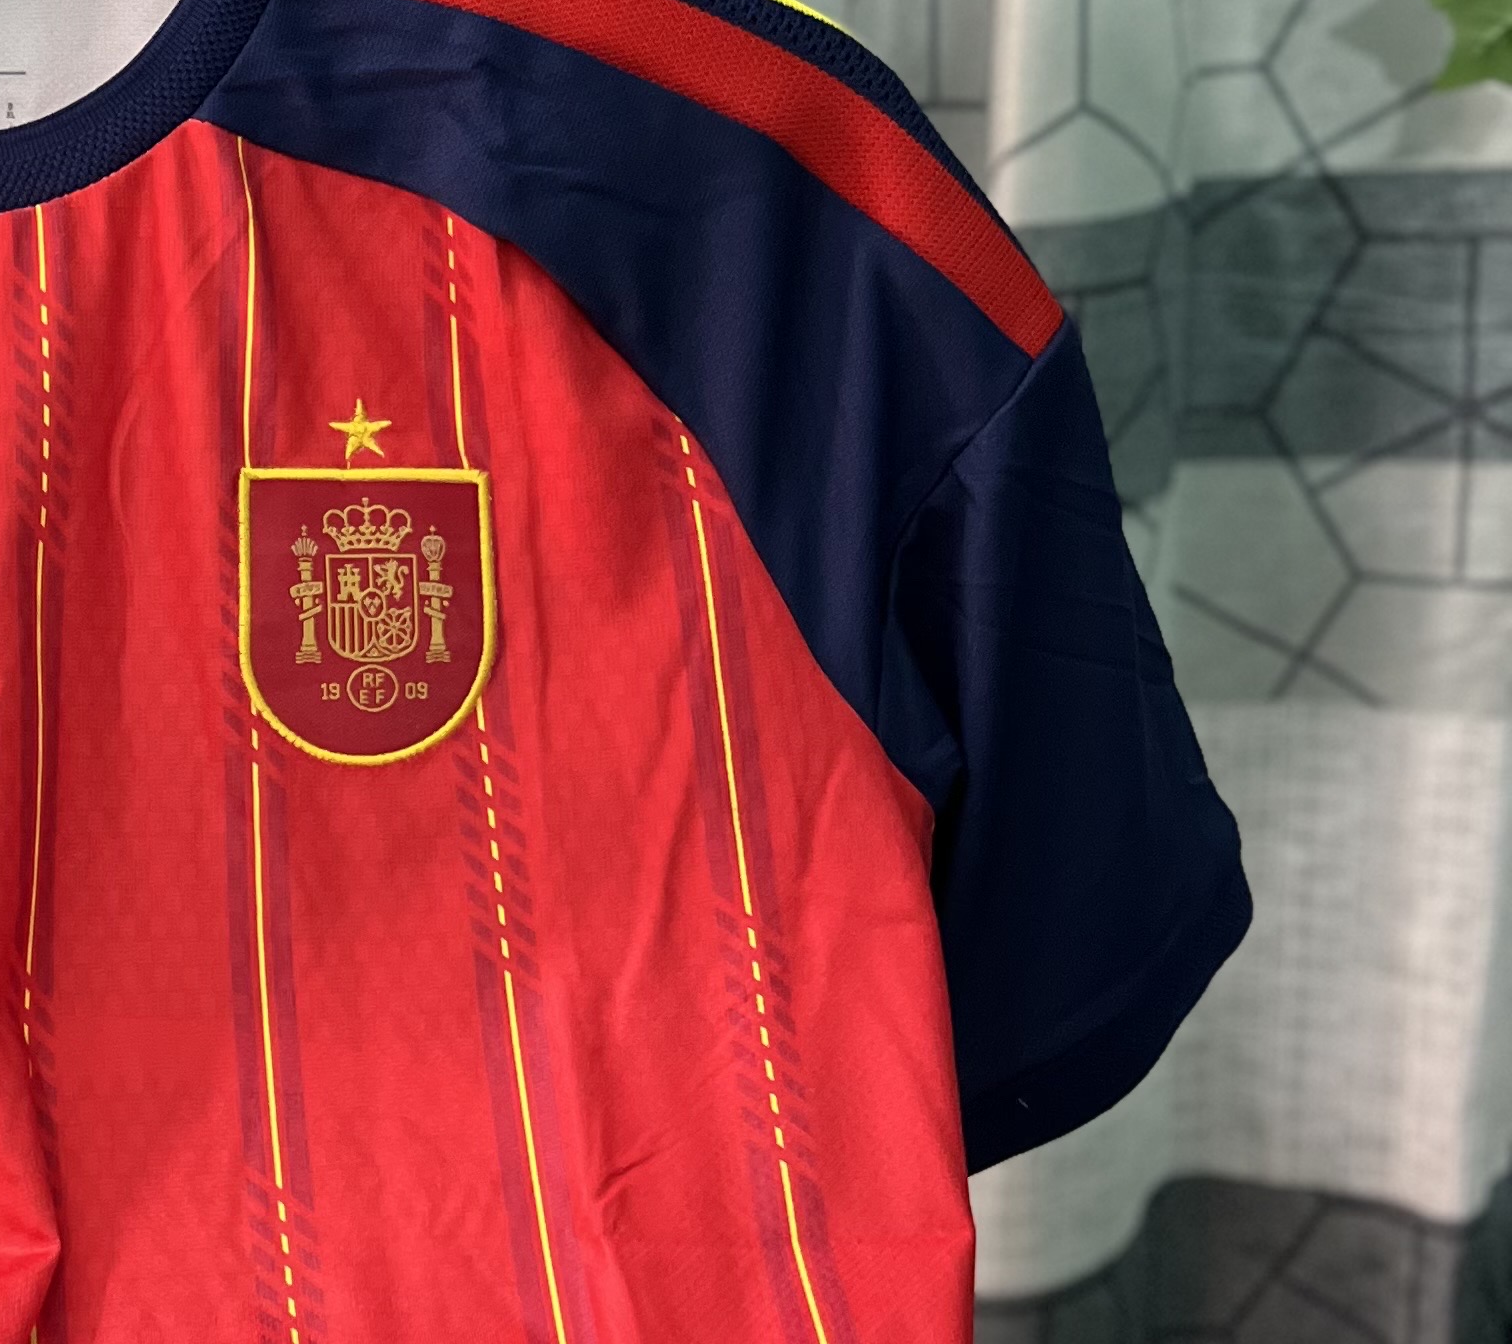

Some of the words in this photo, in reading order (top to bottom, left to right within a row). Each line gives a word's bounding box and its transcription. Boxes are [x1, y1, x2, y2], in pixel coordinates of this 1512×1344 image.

[362, 672, 385, 687] RF
[320, 682, 341, 700] 19
[404, 682, 428, 699] 09
